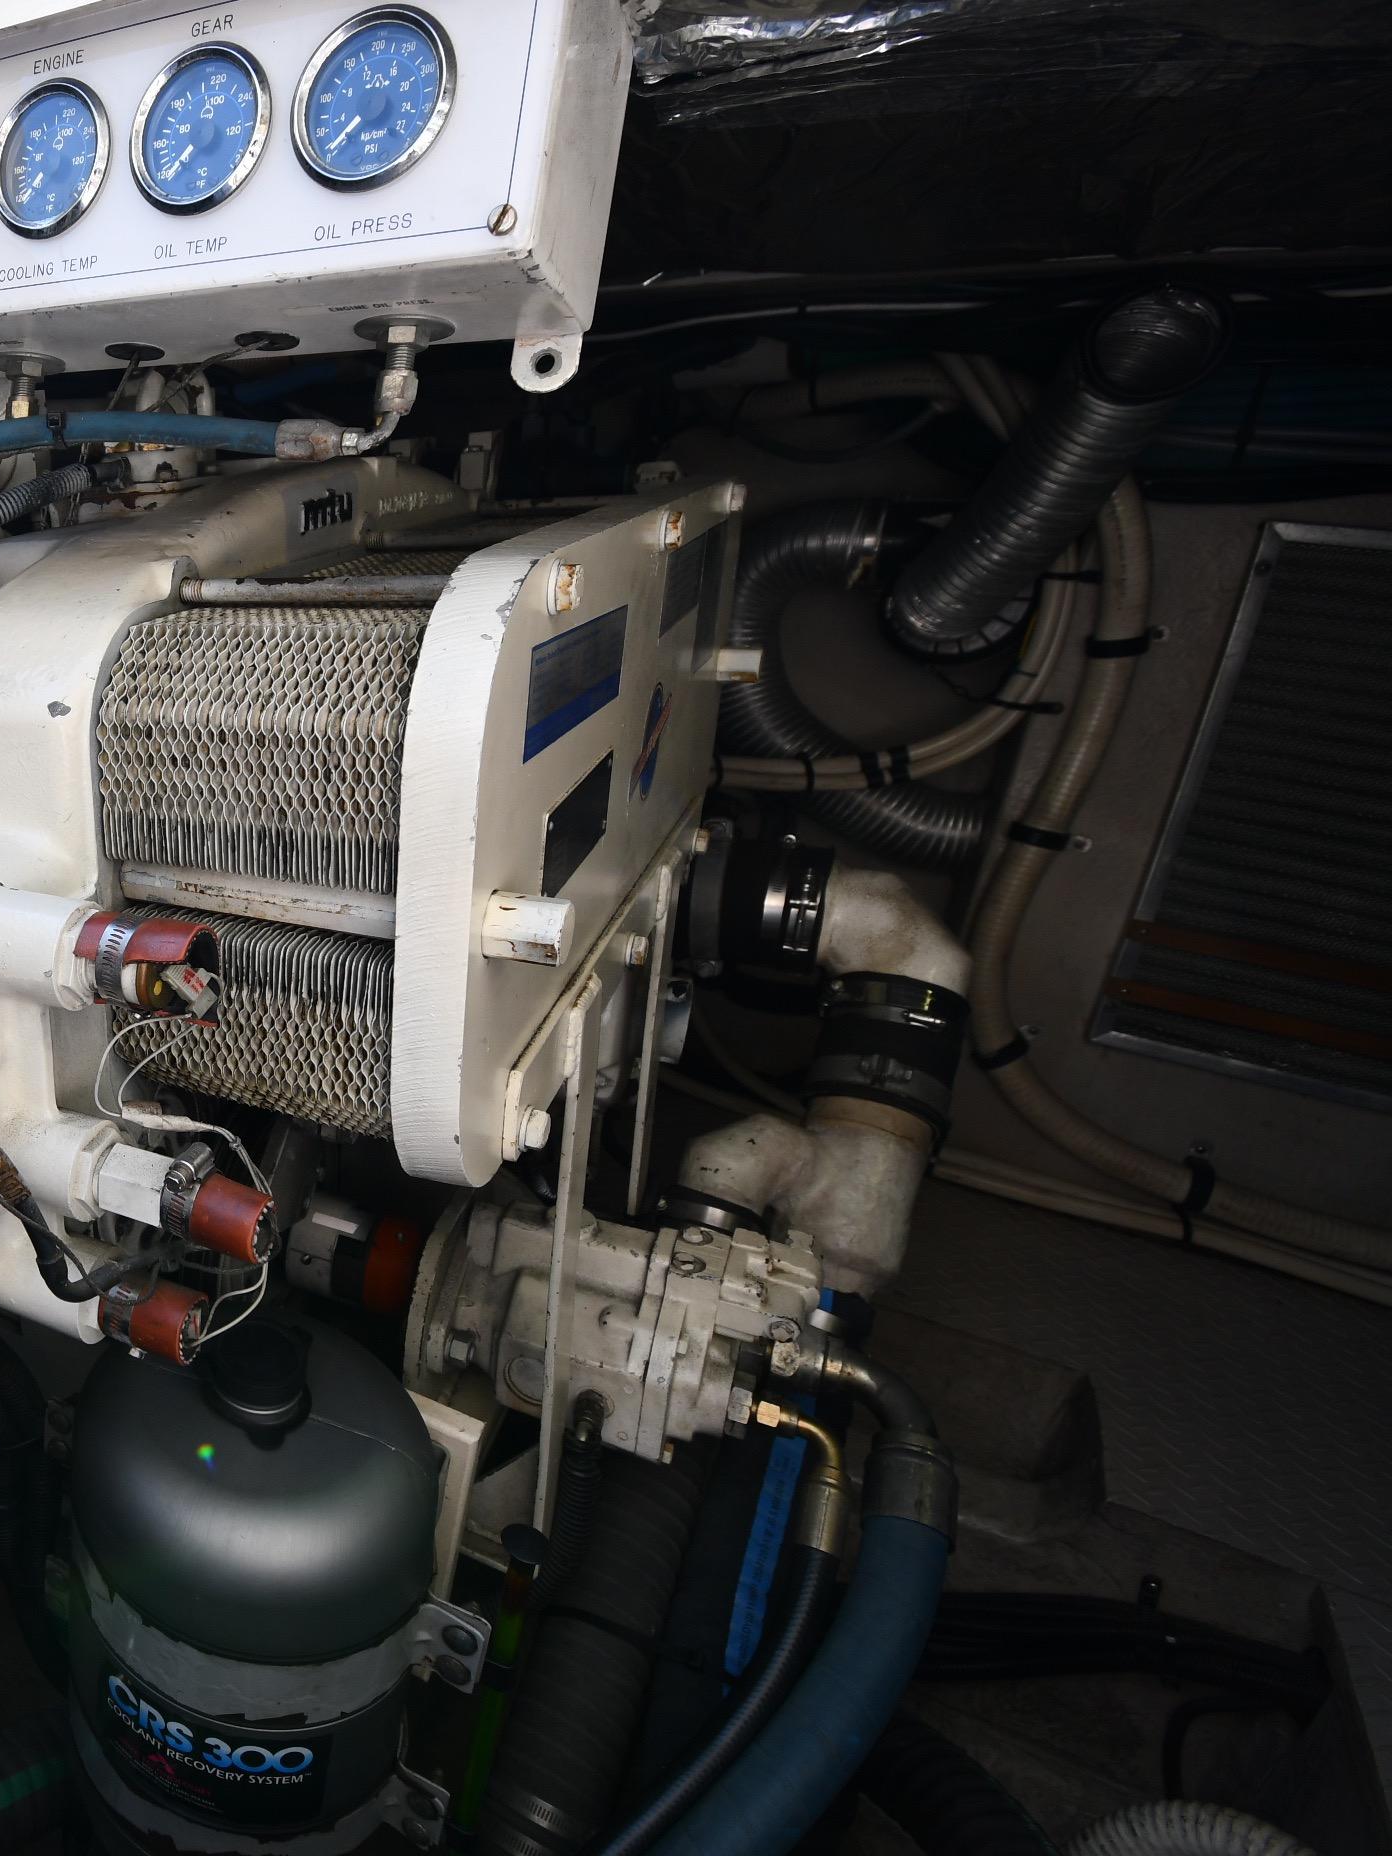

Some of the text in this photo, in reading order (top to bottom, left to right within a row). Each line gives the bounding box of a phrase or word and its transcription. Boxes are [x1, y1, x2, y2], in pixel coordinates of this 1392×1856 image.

[191, 14, 234, 38] GEAR
[371, 39, 386, 51] 200
[401, 41, 416, 53] 250
[33, 49, 85, 75] ENGINE
[343, 58, 356, 69] 150
[363, 71, 371, 81] 12
[389, 66, 398, 77] 16
[210, 73, 227, 85] 220
[347, 87, 353, 97] 8
[400, 81, 410, 92] 20
[210, 95, 225, 106] 100
[320, 93, 332, 103] 100
[170, 98, 185, 110] 190
[401, 102, 411, 113] 24
[62, 107, 76, 118] 220
[340, 112, 346, 122] 4
[179, 123, 191, 134] 80
[396, 119, 405, 130] 27
[30, 129, 42, 139] 190
[61, 127, 74, 137] 100
[226, 125, 241, 136] 120
[316, 127, 326, 137] 50
[153, 138, 167, 149] 160
[364, 144, 378, 154] PSI
[72, 156, 85, 165] 120
[14, 165, 25, 174] 160
[314, 212, 413, 242] OIL PRESS
[154, 236, 228, 260] OIL TEMP
[62, 255, 98, 273] TEMP
[328, 303, 368, 313] ENGINE
[108, 1675, 314, 1774] CRS 300
[107, 1697, 164, 1750] COOLANT
[166, 1748, 244, 1782] RECOVERY
[248, 1774, 304, 1785] SYSTEM
